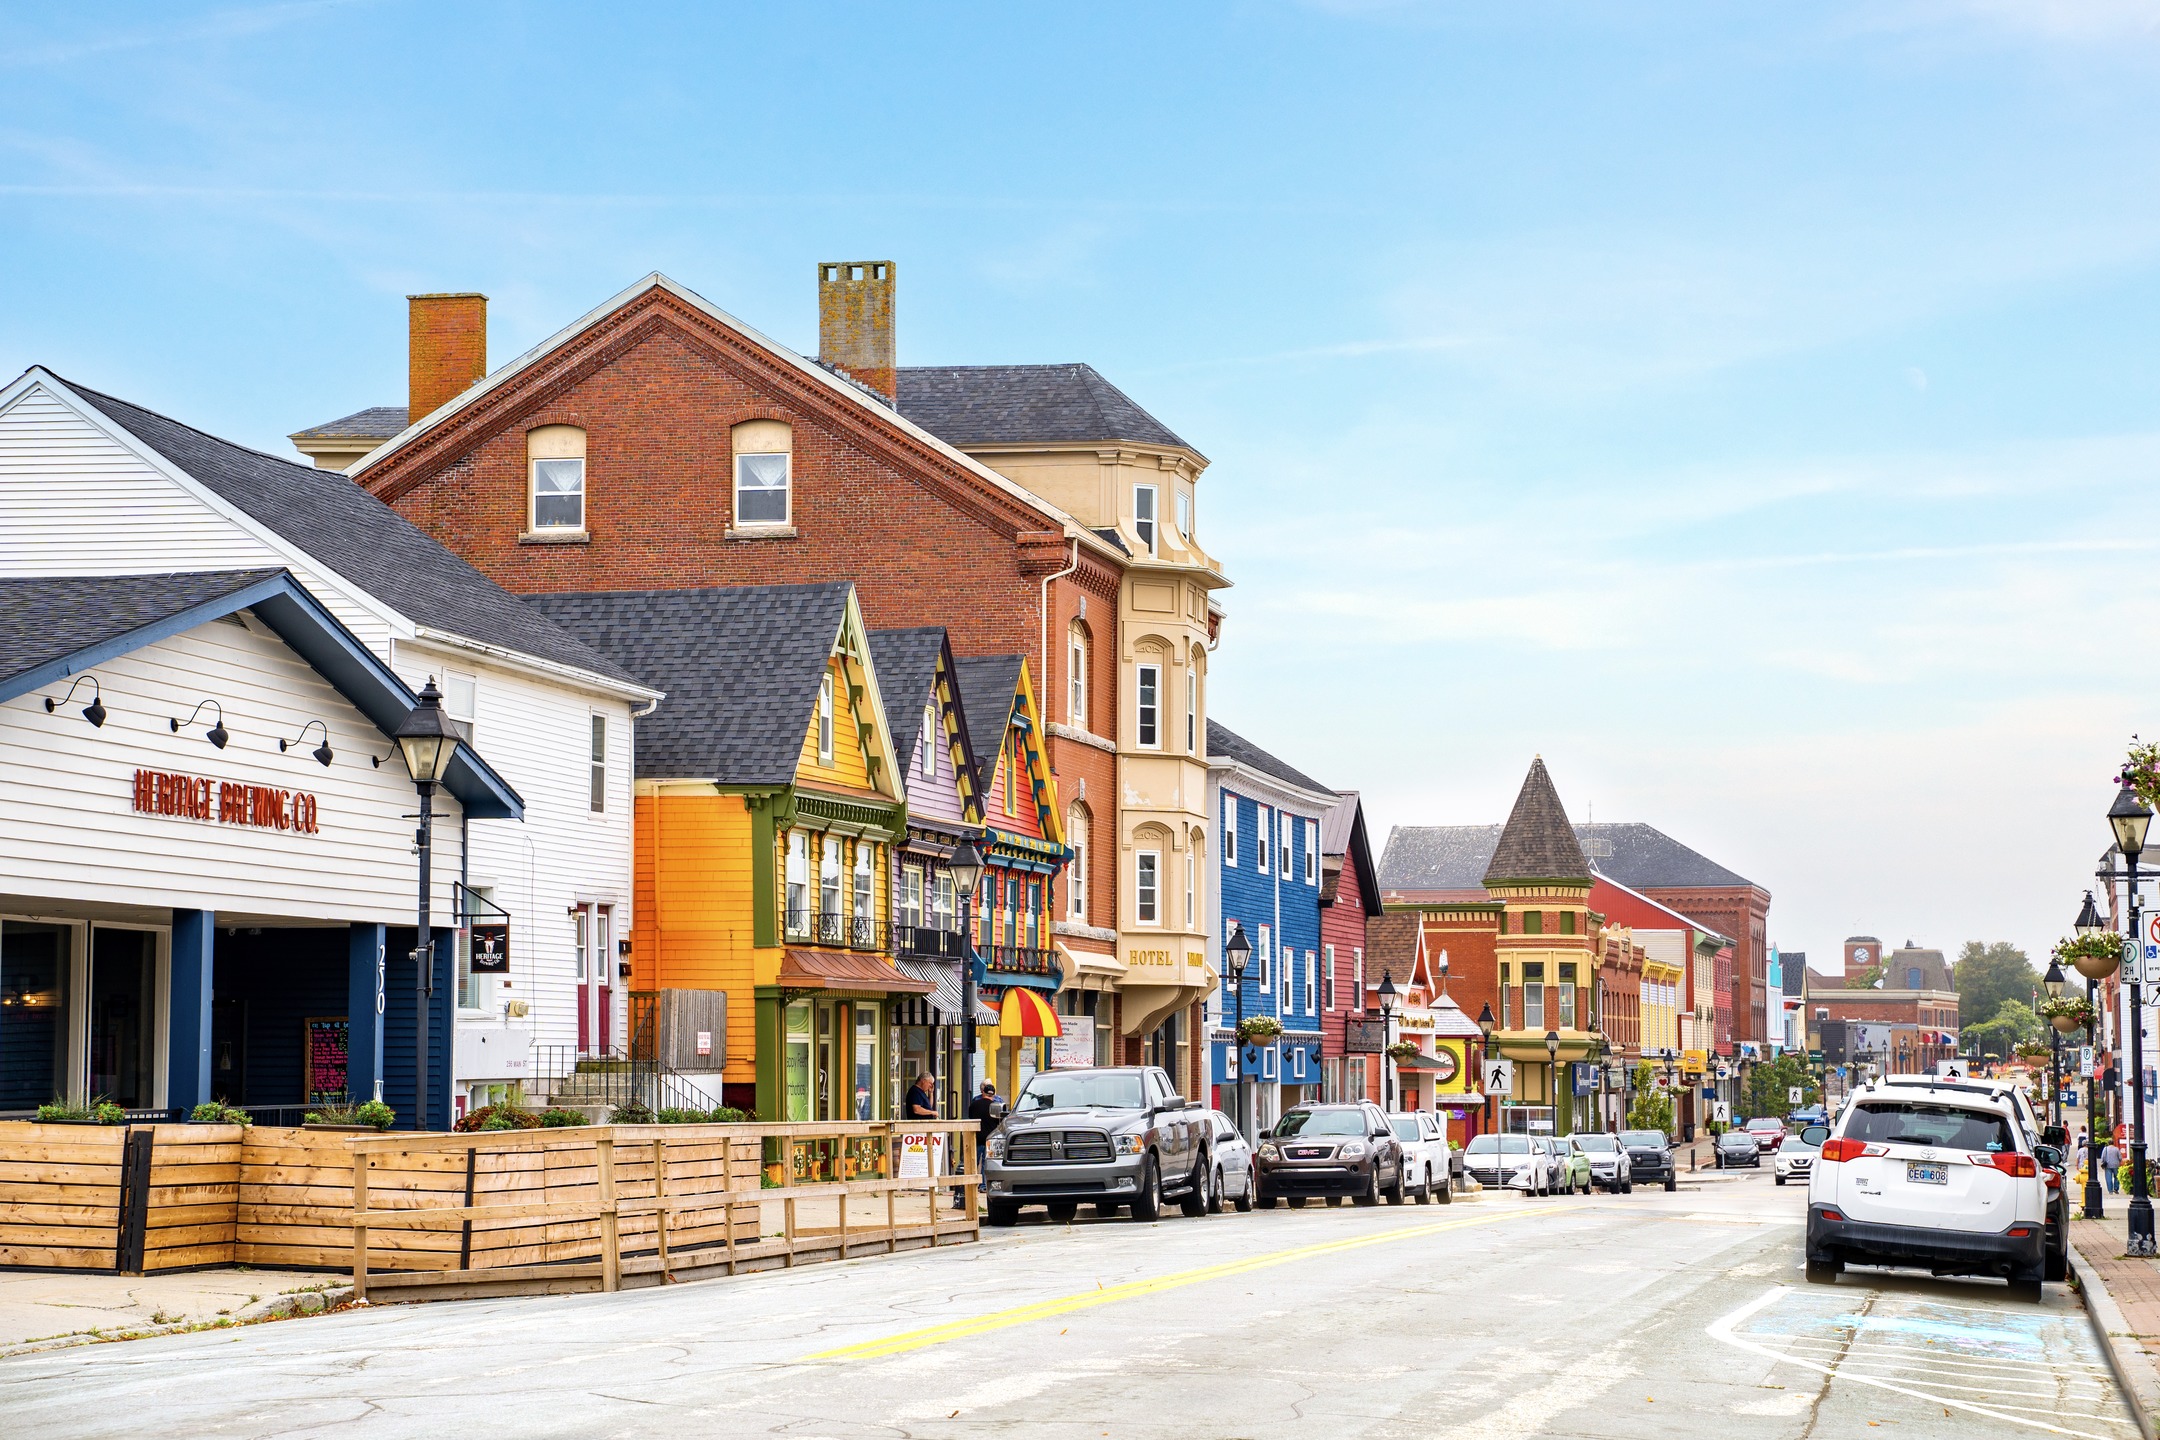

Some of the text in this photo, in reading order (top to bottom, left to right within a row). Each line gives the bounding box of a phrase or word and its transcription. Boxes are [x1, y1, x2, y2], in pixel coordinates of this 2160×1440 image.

[134, 768, 320, 836] HERITAGE BREWING CO.
[475, 952, 504, 960] HERITAGE
[1129, 950, 1174, 966] HOTEL
[2126, 947, 2132, 957] P
[377, 944, 386, 1015] 250
[1908, 1168, 1946, 1181] CEG 608
